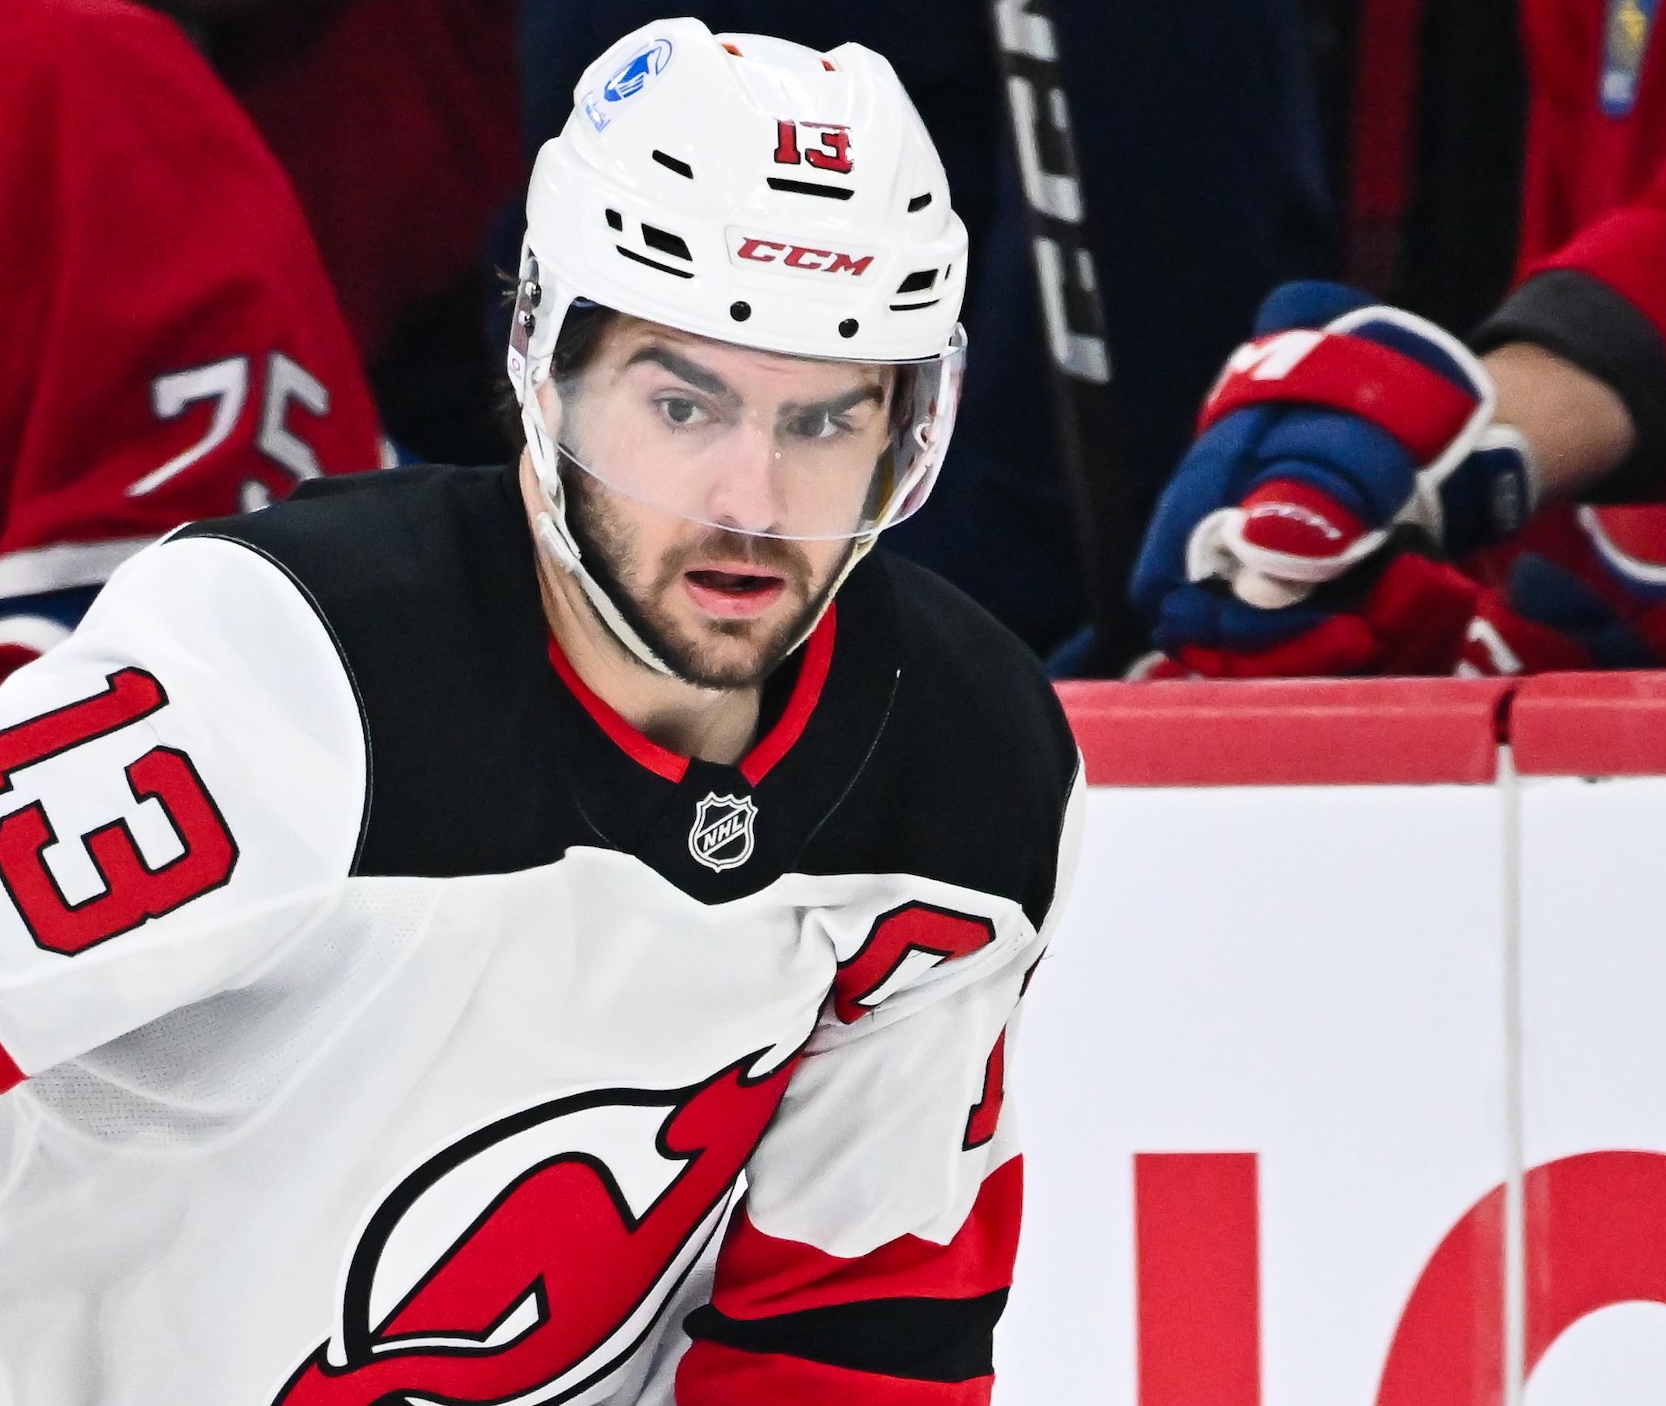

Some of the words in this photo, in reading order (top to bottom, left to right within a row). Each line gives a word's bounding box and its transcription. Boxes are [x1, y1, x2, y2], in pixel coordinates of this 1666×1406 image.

[774, 119, 855, 174] 13
[737, 236, 875, 276] CCM
[125, 352, 330, 516] 75
[702, 814, 745, 852] NHL
